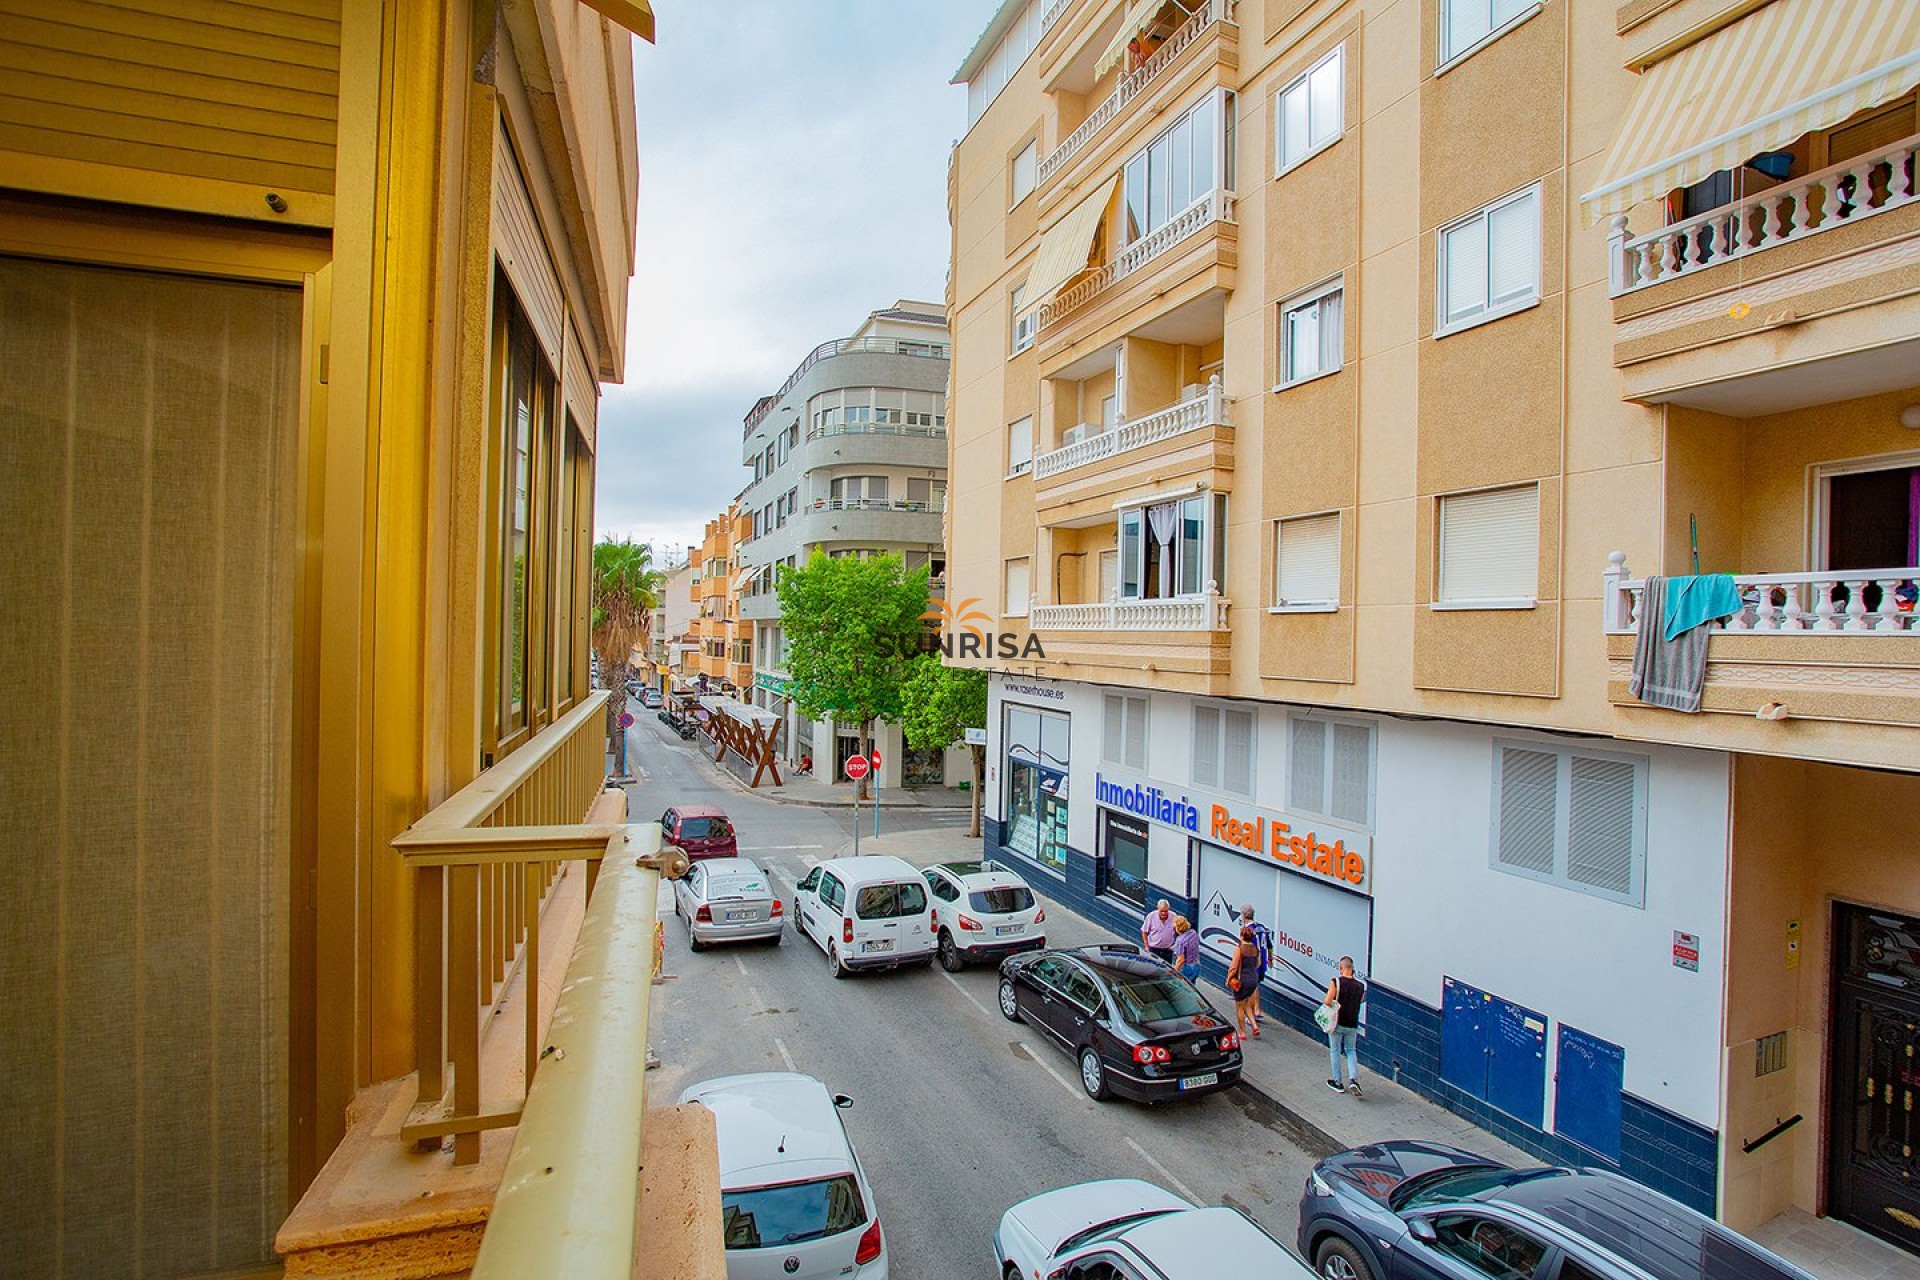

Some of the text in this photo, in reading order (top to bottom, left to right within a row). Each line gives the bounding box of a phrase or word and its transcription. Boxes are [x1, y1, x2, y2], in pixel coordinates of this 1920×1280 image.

[848, 763, 866, 771] STOP
[1095, 771, 1365, 885] Inmobiliaria Real Estate
[1279, 930, 1313, 957] House
